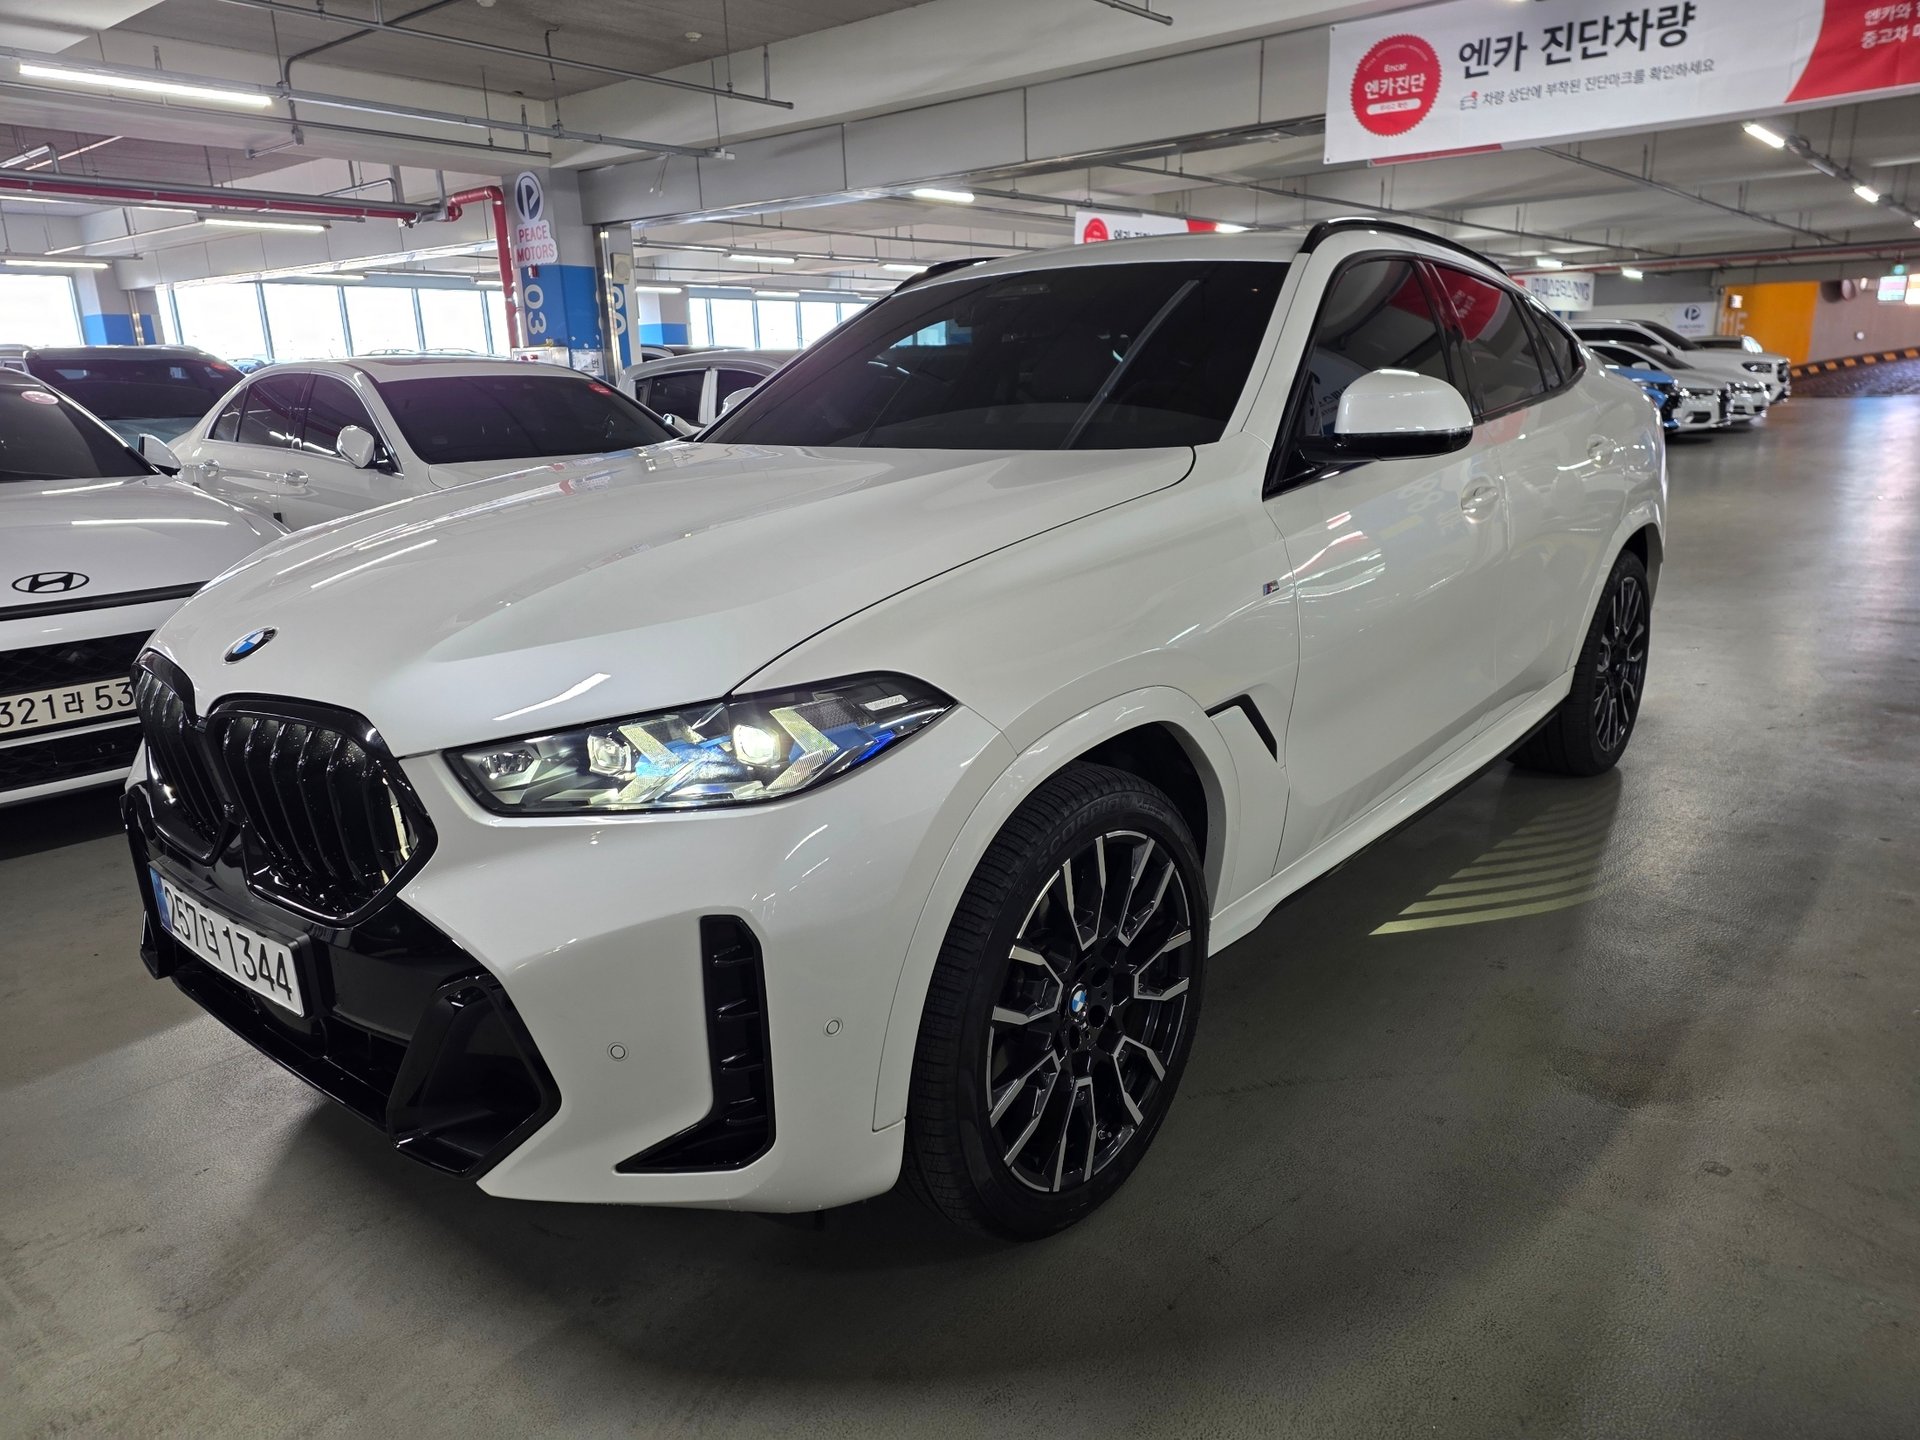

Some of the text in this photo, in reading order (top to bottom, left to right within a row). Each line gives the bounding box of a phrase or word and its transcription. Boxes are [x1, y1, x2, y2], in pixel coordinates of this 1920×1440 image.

[1864, 2, 1913, 26] 엔카와
[1459, 31, 1528, 79] 엔카
[1541, 1, 1696, 66] 진단차량
[1861, 25, 1910, 49] 중고차
[1364, 73, 1427, 99] 엔카진단
[1482, 58, 1715, 105] 차량 상단에 부착된 진단마크를 확인하세요
[518, 225, 549, 243] PEACE
[516, 243, 555, 262] MOTORS
[524, 284, 547, 335] 03
[0, 682, 134, 729] 321라 53
[165, 886, 293, 1003] 257더 1344
